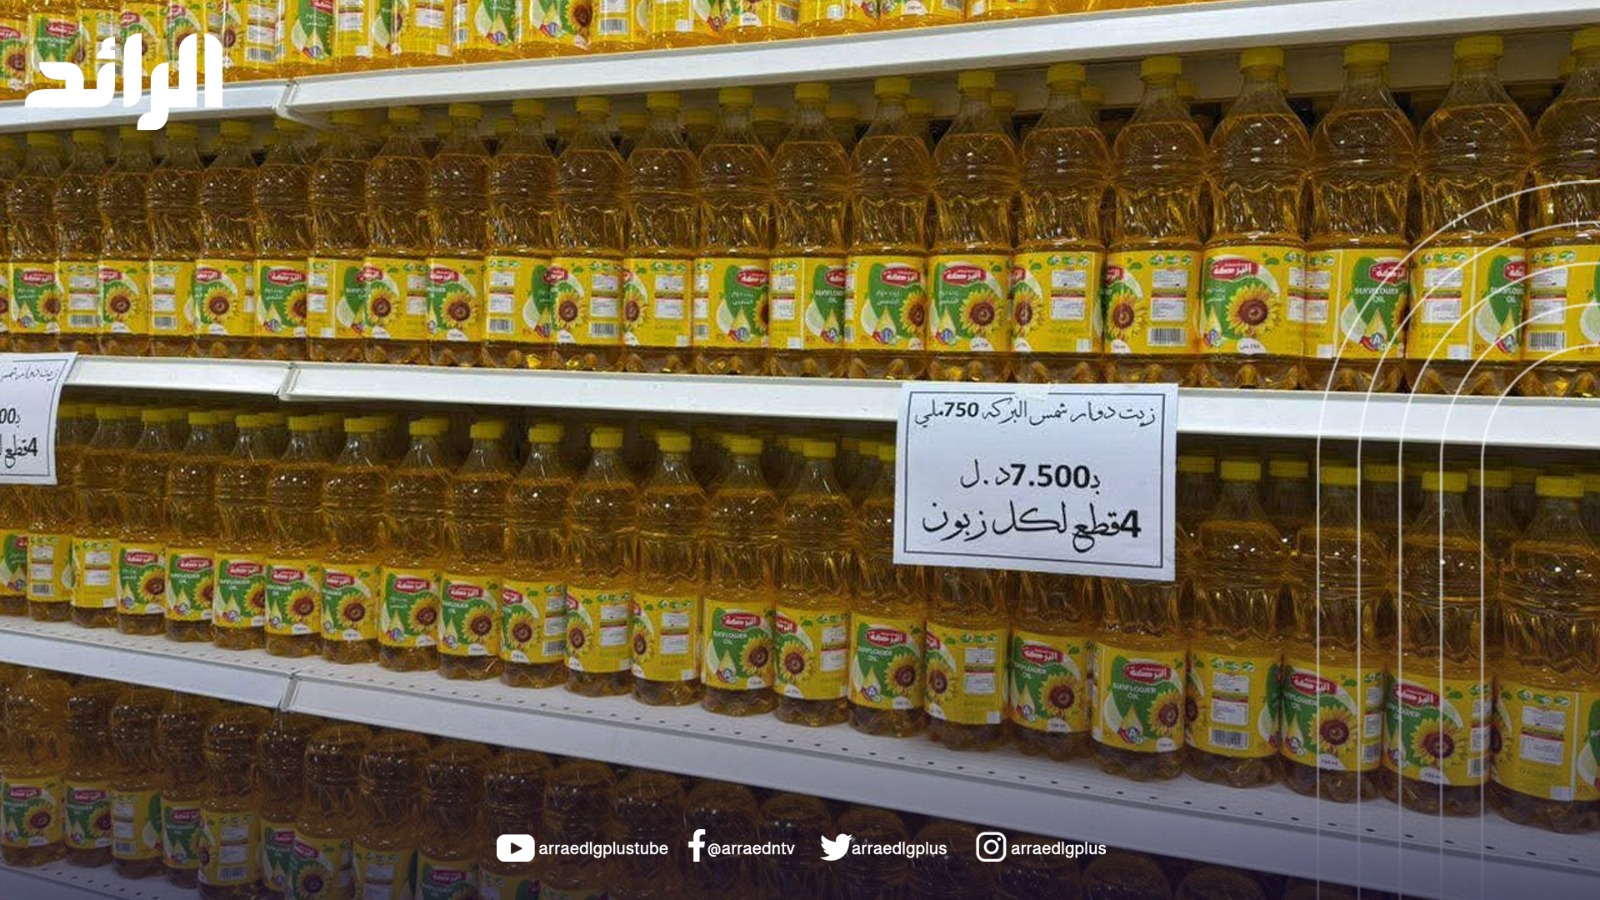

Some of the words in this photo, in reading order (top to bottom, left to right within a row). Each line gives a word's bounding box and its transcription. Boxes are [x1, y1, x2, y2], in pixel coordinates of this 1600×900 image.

[1029, 402, 1068, 426] شمس
[1069, 401, 1116, 423] دوار
[1119, 402, 1157, 427] زيت
[922, 502, 987, 542] زبون
[992, 500, 1067, 534] لكل
